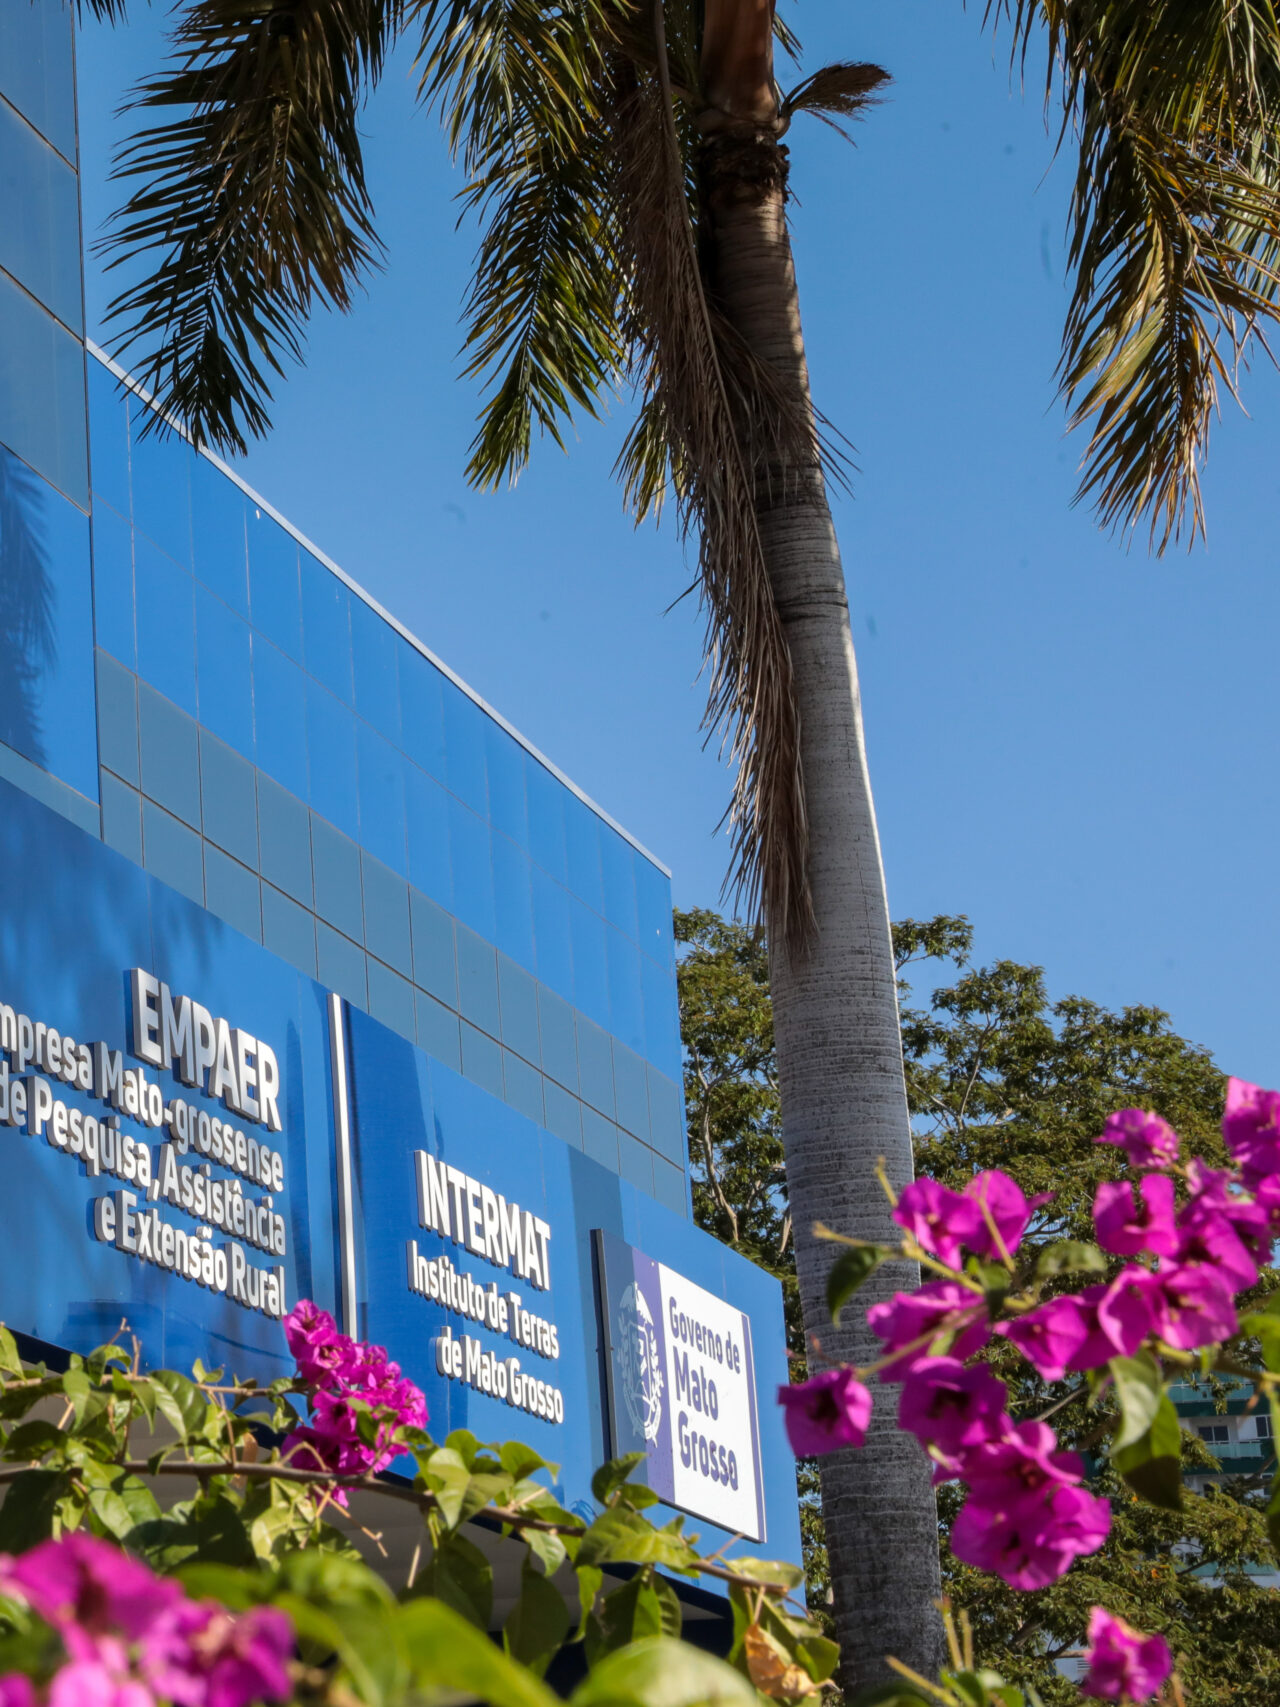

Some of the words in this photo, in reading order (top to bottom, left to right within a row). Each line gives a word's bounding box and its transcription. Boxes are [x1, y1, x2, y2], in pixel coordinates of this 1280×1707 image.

[130, 967, 282, 1131] EMPAER
[27, 1075, 160, 1201] Pesquisa,
[158, 1143, 286, 1256] Assistência
[95, 1041, 284, 1192] Mato-grossense
[95, 1196, 116, 1241] e
[116, 1189, 227, 1292] Extensão
[225, 1241, 287, 1318] Rural
[414, 1149, 551, 1291] INTERMAT
[406, 1240, 486, 1321] Instituto
[484, 1282, 508, 1333] de
[506, 1291, 559, 1359] Terras
[669, 1296, 723, 1364] Governo
[725, 1331, 741, 1374] de
[436, 1326, 462, 1378] de
[460, 1334, 507, 1398] Mato
[505, 1357, 563, 1424] Grosso
[673, 1345, 719, 1420] Mato
[678, 1410, 739, 1491] Grosso
